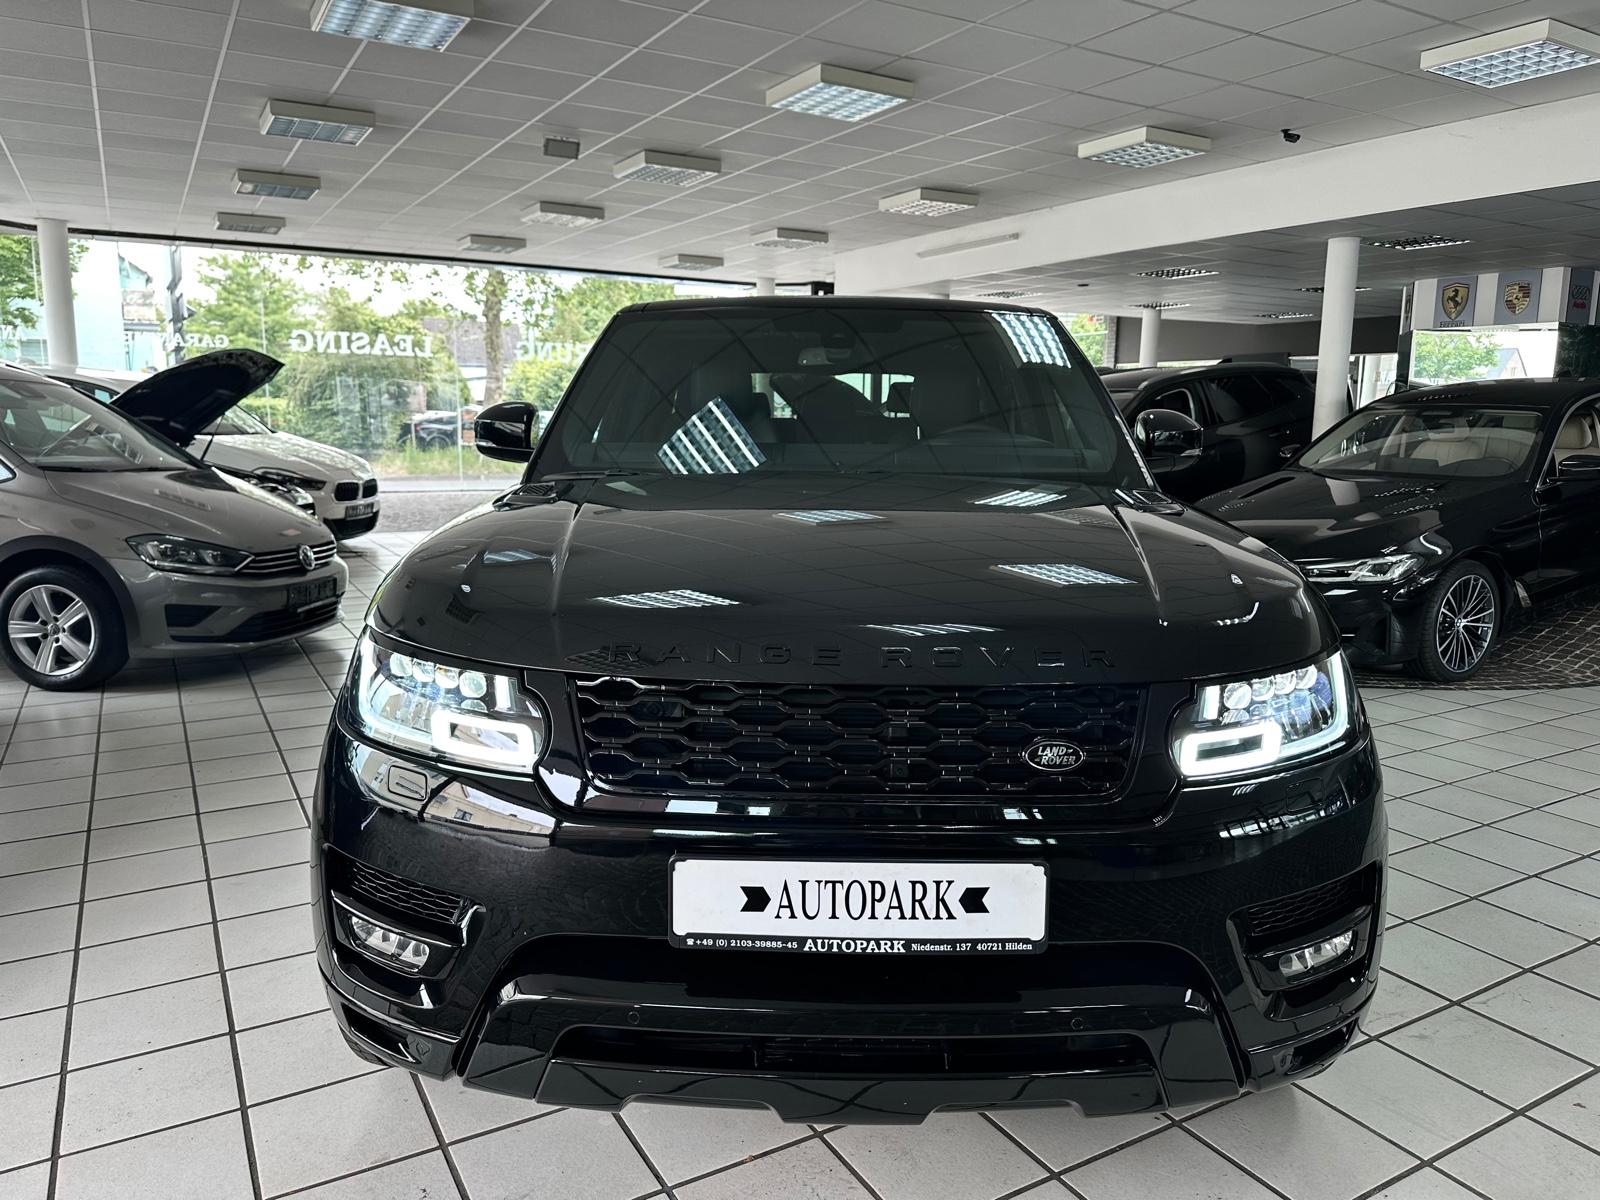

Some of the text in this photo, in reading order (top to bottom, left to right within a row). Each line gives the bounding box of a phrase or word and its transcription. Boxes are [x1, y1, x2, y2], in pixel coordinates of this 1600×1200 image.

[608, 644, 1116, 669] RANGE ROVER
[774, 879, 957, 920] AUTOPARK
[696, 938, 1033, 953] +49 (0) 2103-39885-45 AUTOPARK Niedenstr. 137 40721 Hilden
